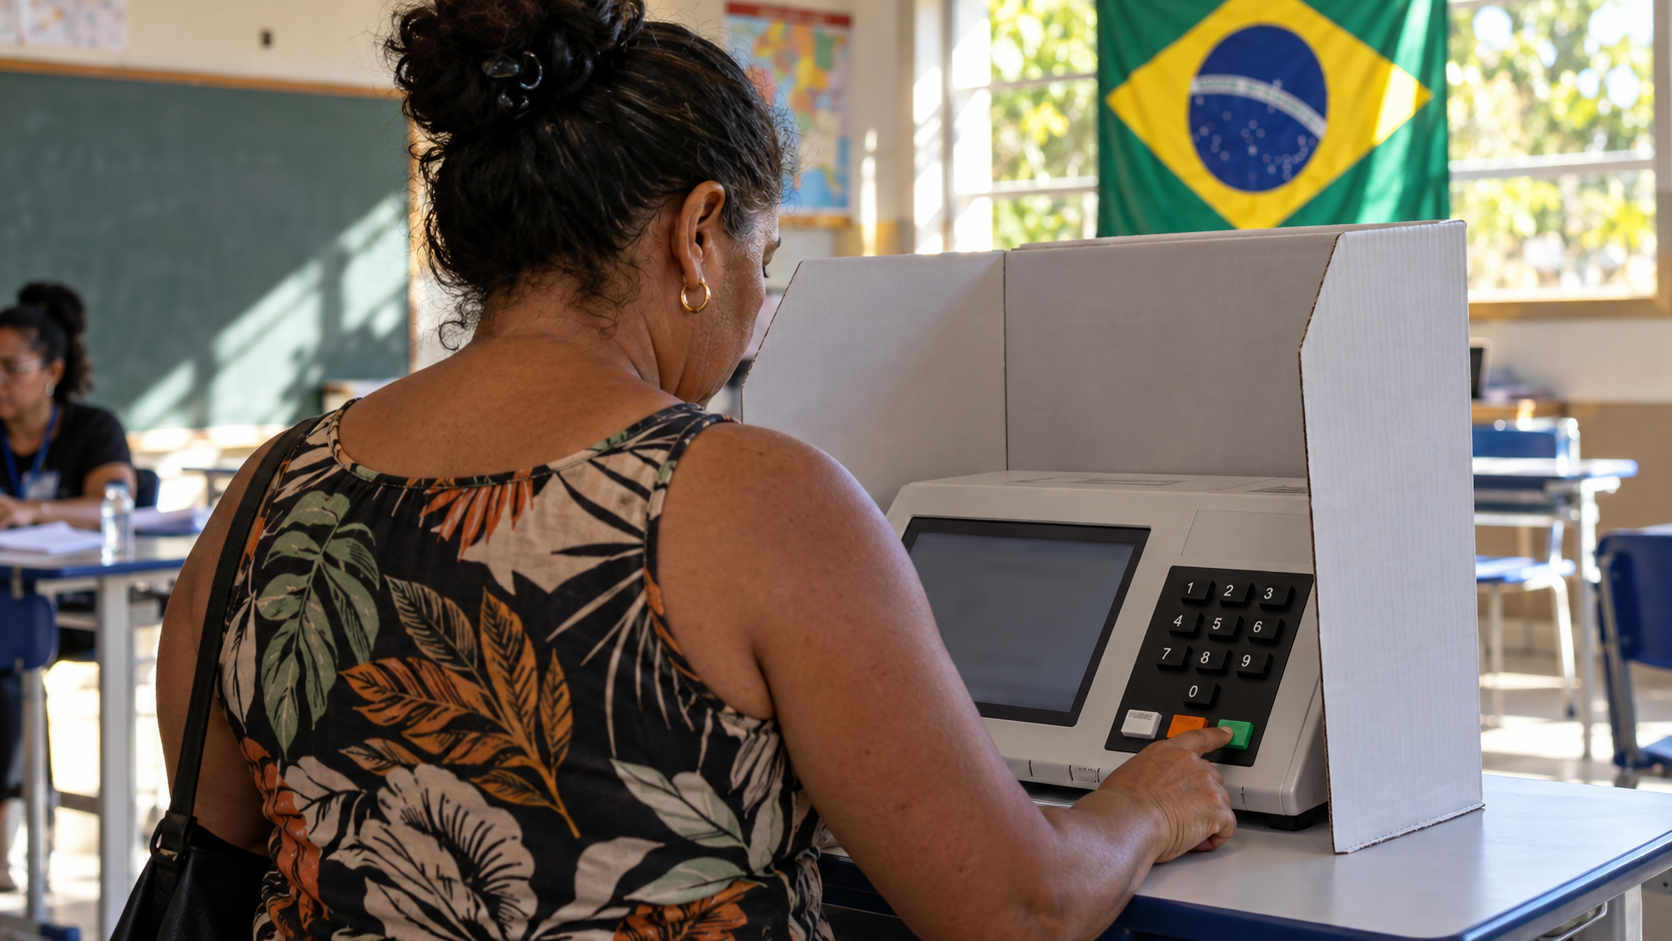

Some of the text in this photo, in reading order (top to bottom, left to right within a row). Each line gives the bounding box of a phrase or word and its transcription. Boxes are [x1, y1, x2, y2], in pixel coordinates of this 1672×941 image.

[1188, 582, 1273, 599] 1 2 3
[1174, 615, 1262, 632] 4 5 6
[1162, 648, 1251, 667] 7 8 9
[1189, 685, 1198, 697] 0
